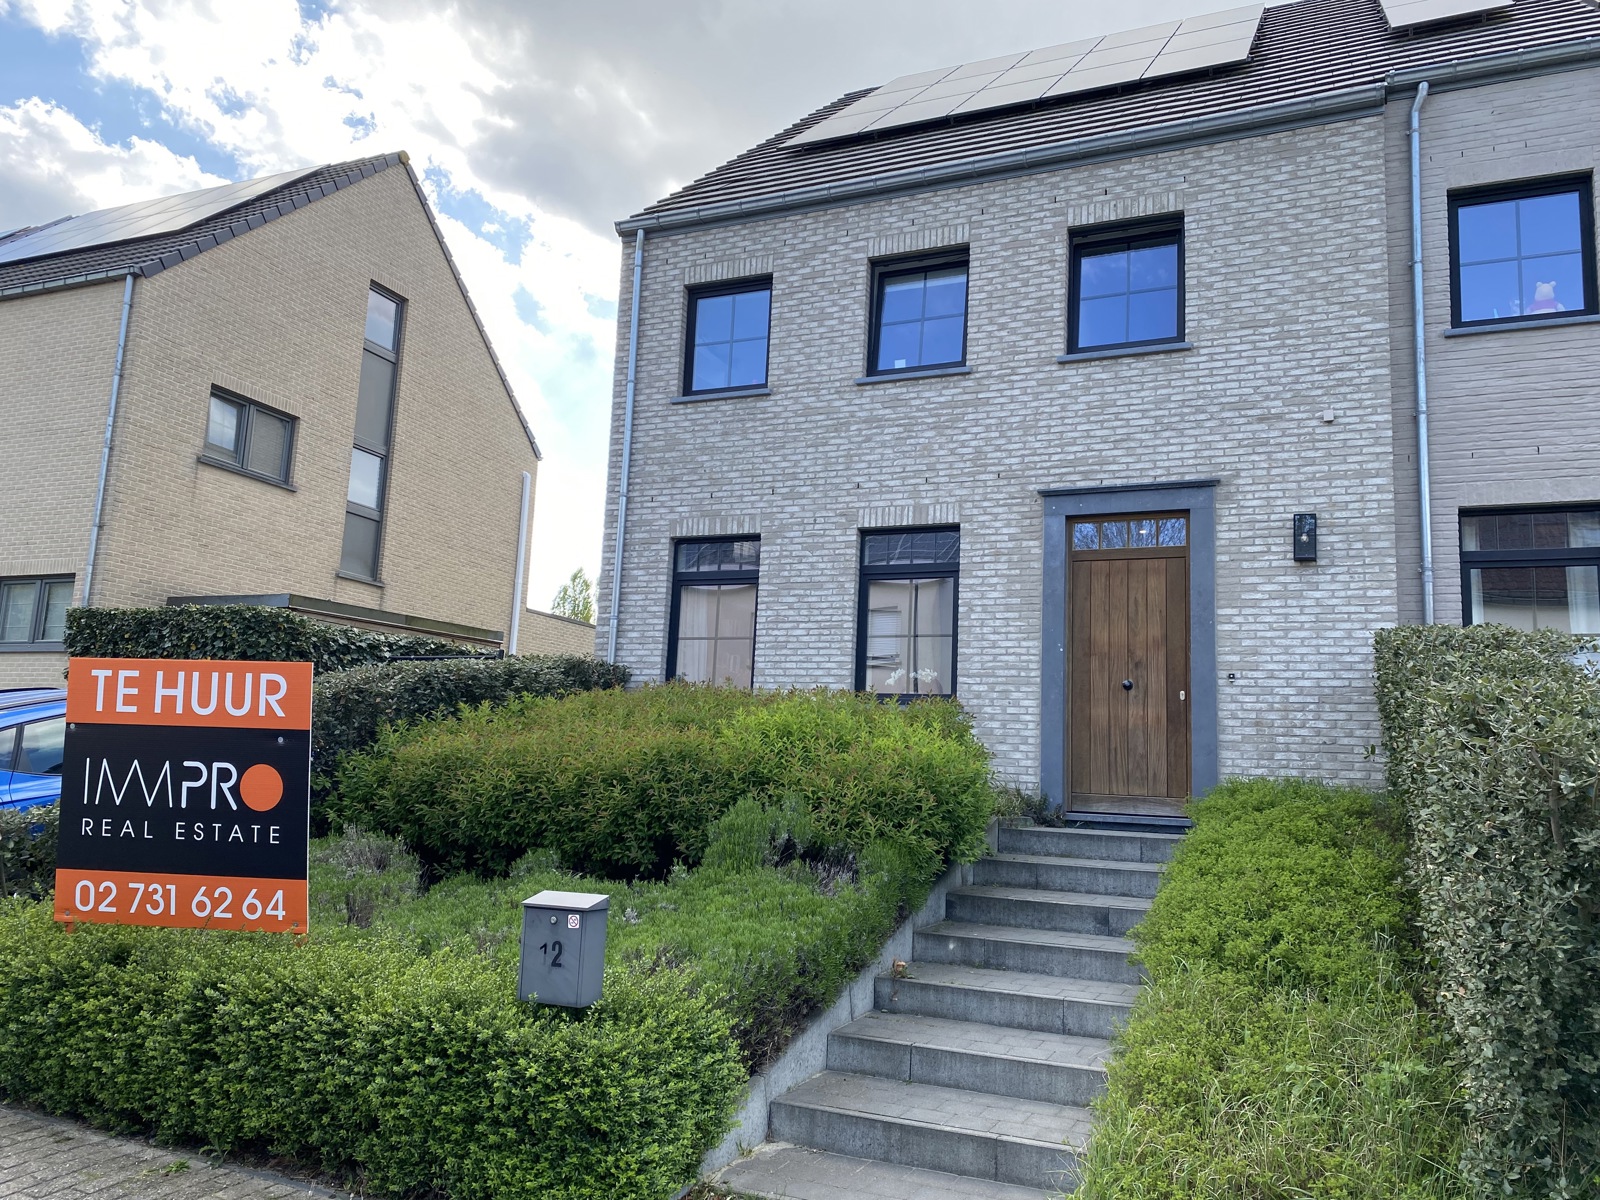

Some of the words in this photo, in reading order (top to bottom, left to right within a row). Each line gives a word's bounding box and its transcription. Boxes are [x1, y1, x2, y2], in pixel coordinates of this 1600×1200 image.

[91, 669, 139, 712] TE
[154, 671, 287, 717] HUUR
[81, 818, 153, 839] REAL
[175, 822, 280, 844] ESTATE
[74, 880, 117, 912] 02
[128, 882, 176, 915] 731
[191, 886, 233, 918] 62
[242, 888, 286, 921] 64
[540, 940, 563, 968] 12
